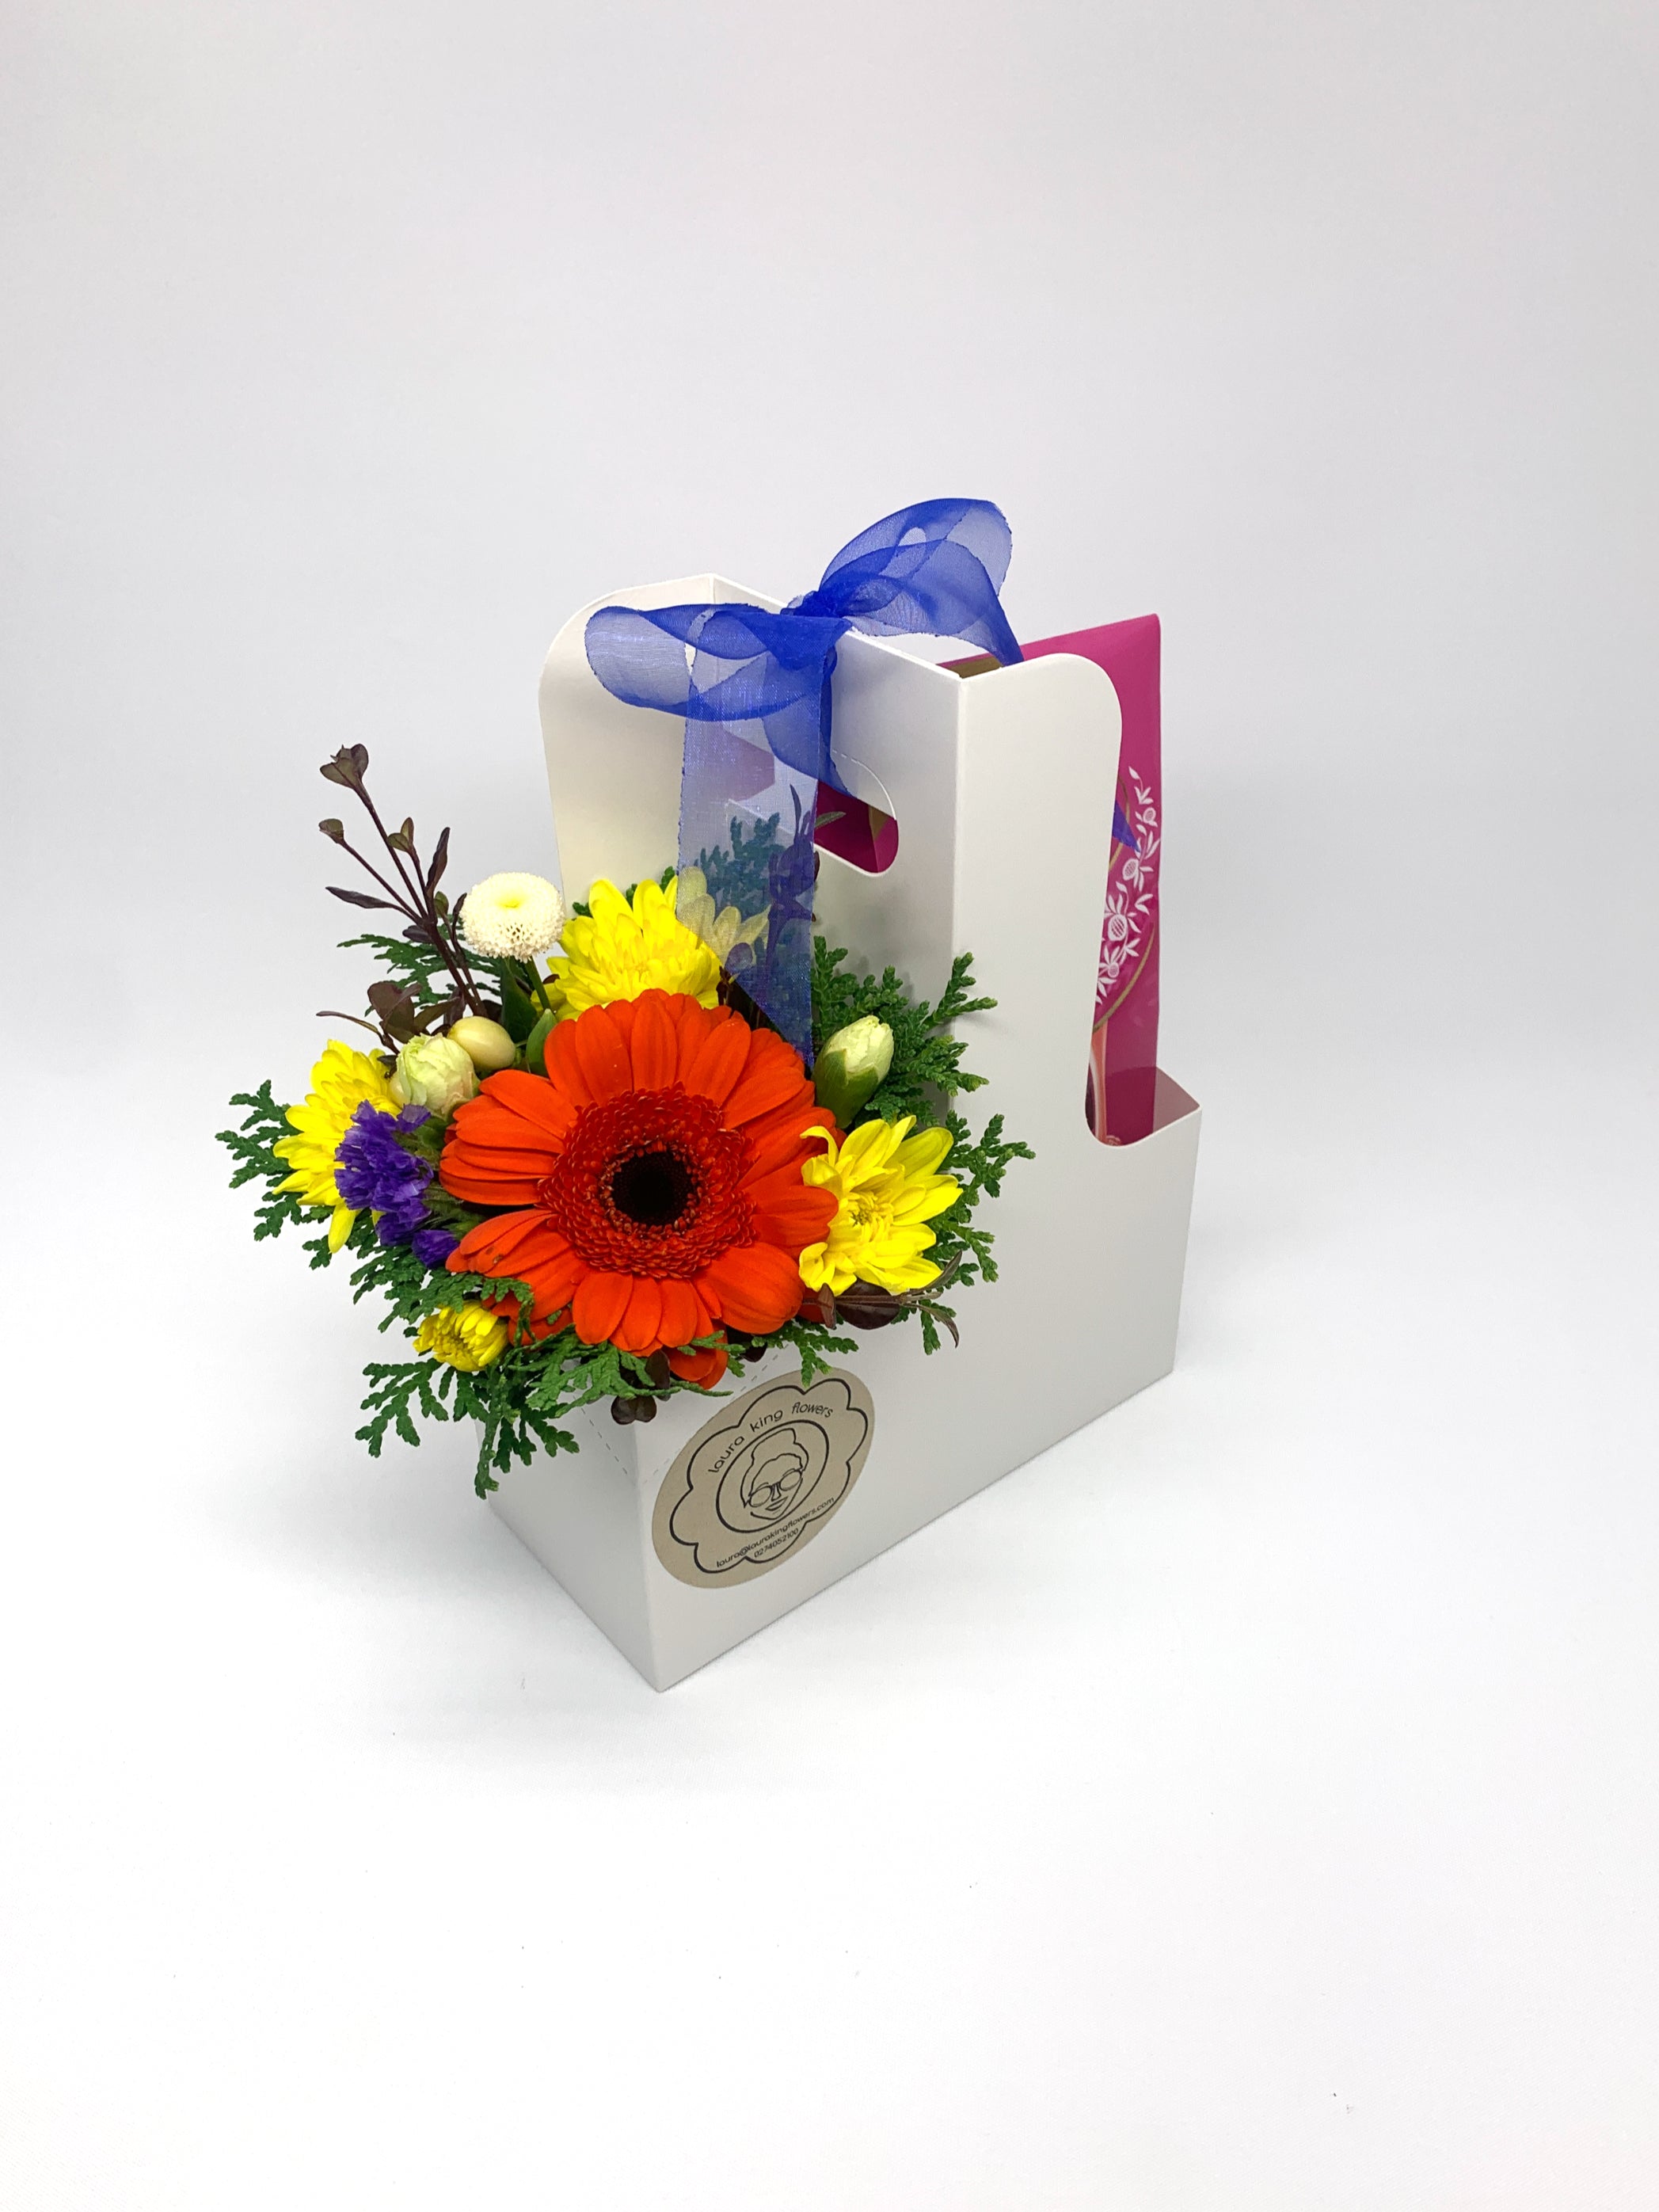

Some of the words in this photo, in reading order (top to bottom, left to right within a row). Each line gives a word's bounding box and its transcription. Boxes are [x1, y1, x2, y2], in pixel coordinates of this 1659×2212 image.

[708, 1436, 744, 1472] laura
[751, 1410, 783, 1432] king
[792, 1402, 833, 1418] flowers
[716, 1498, 835, 1567] laura@laurakingflowers.com
[754, 1528, 799, 1558] 0274052100
